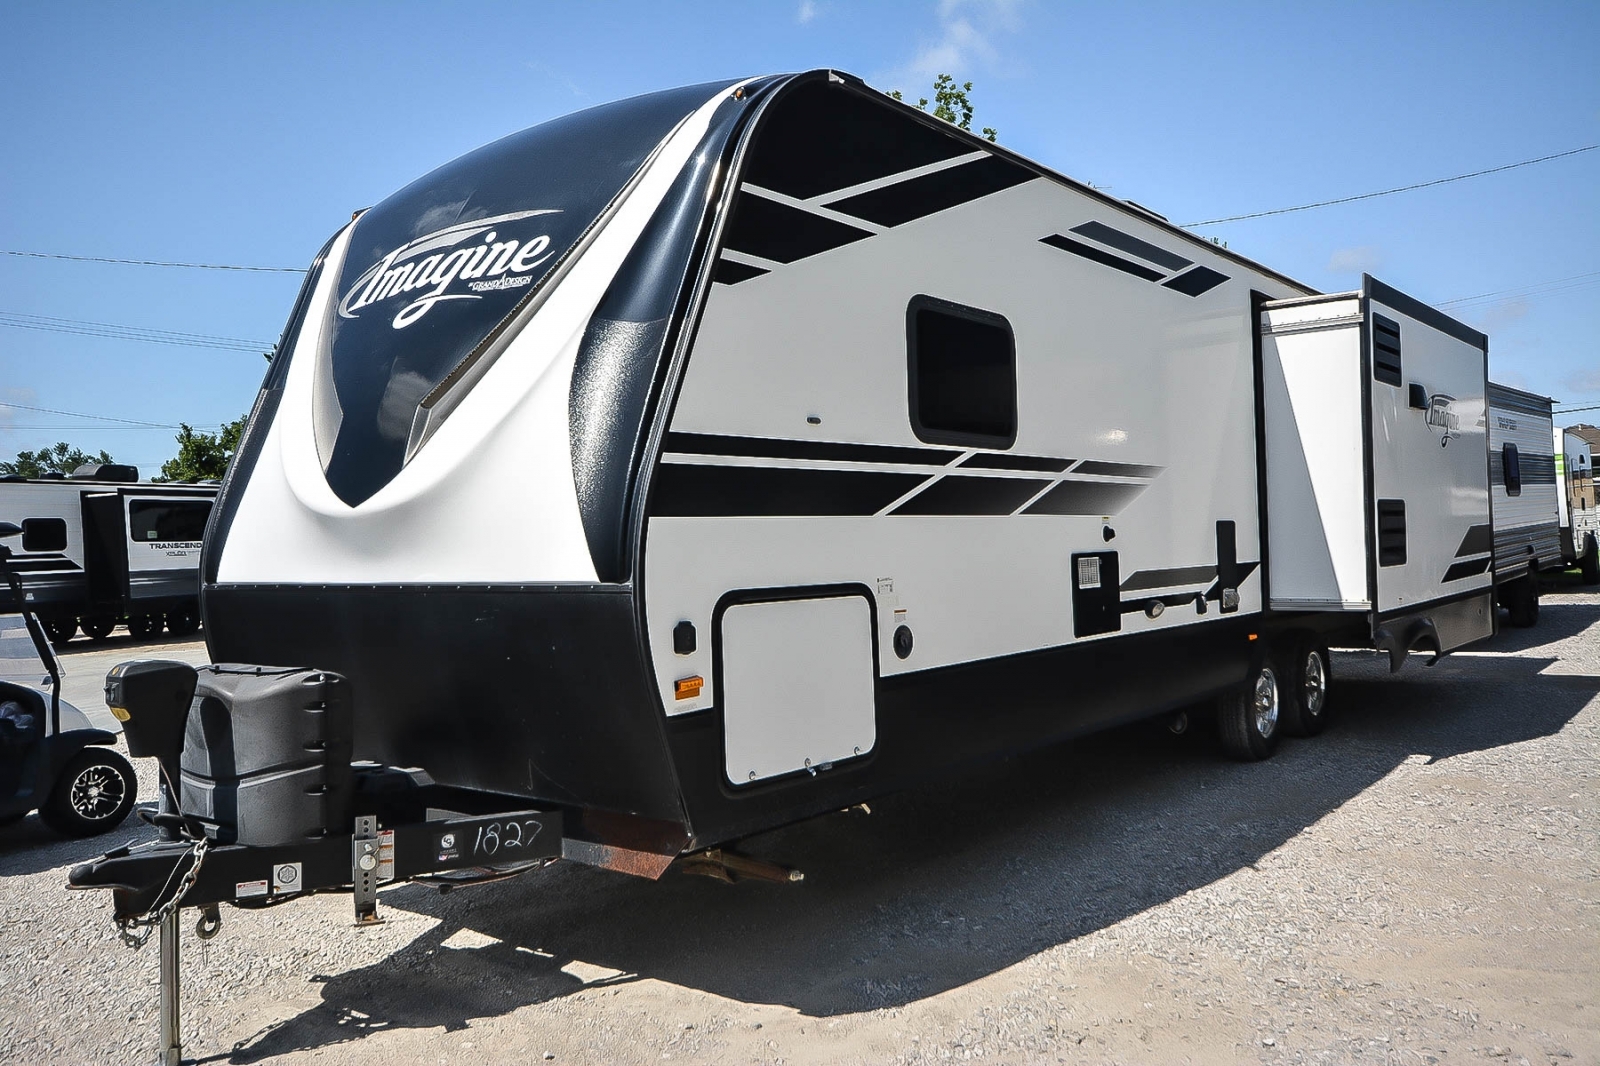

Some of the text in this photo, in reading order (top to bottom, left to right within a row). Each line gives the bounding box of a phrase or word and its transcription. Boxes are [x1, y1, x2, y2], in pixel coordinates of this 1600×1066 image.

[339, 231, 556, 330] Imagine
[1426, 394, 1460, 448] Imagine
[473, 820, 543, 856] 1827
